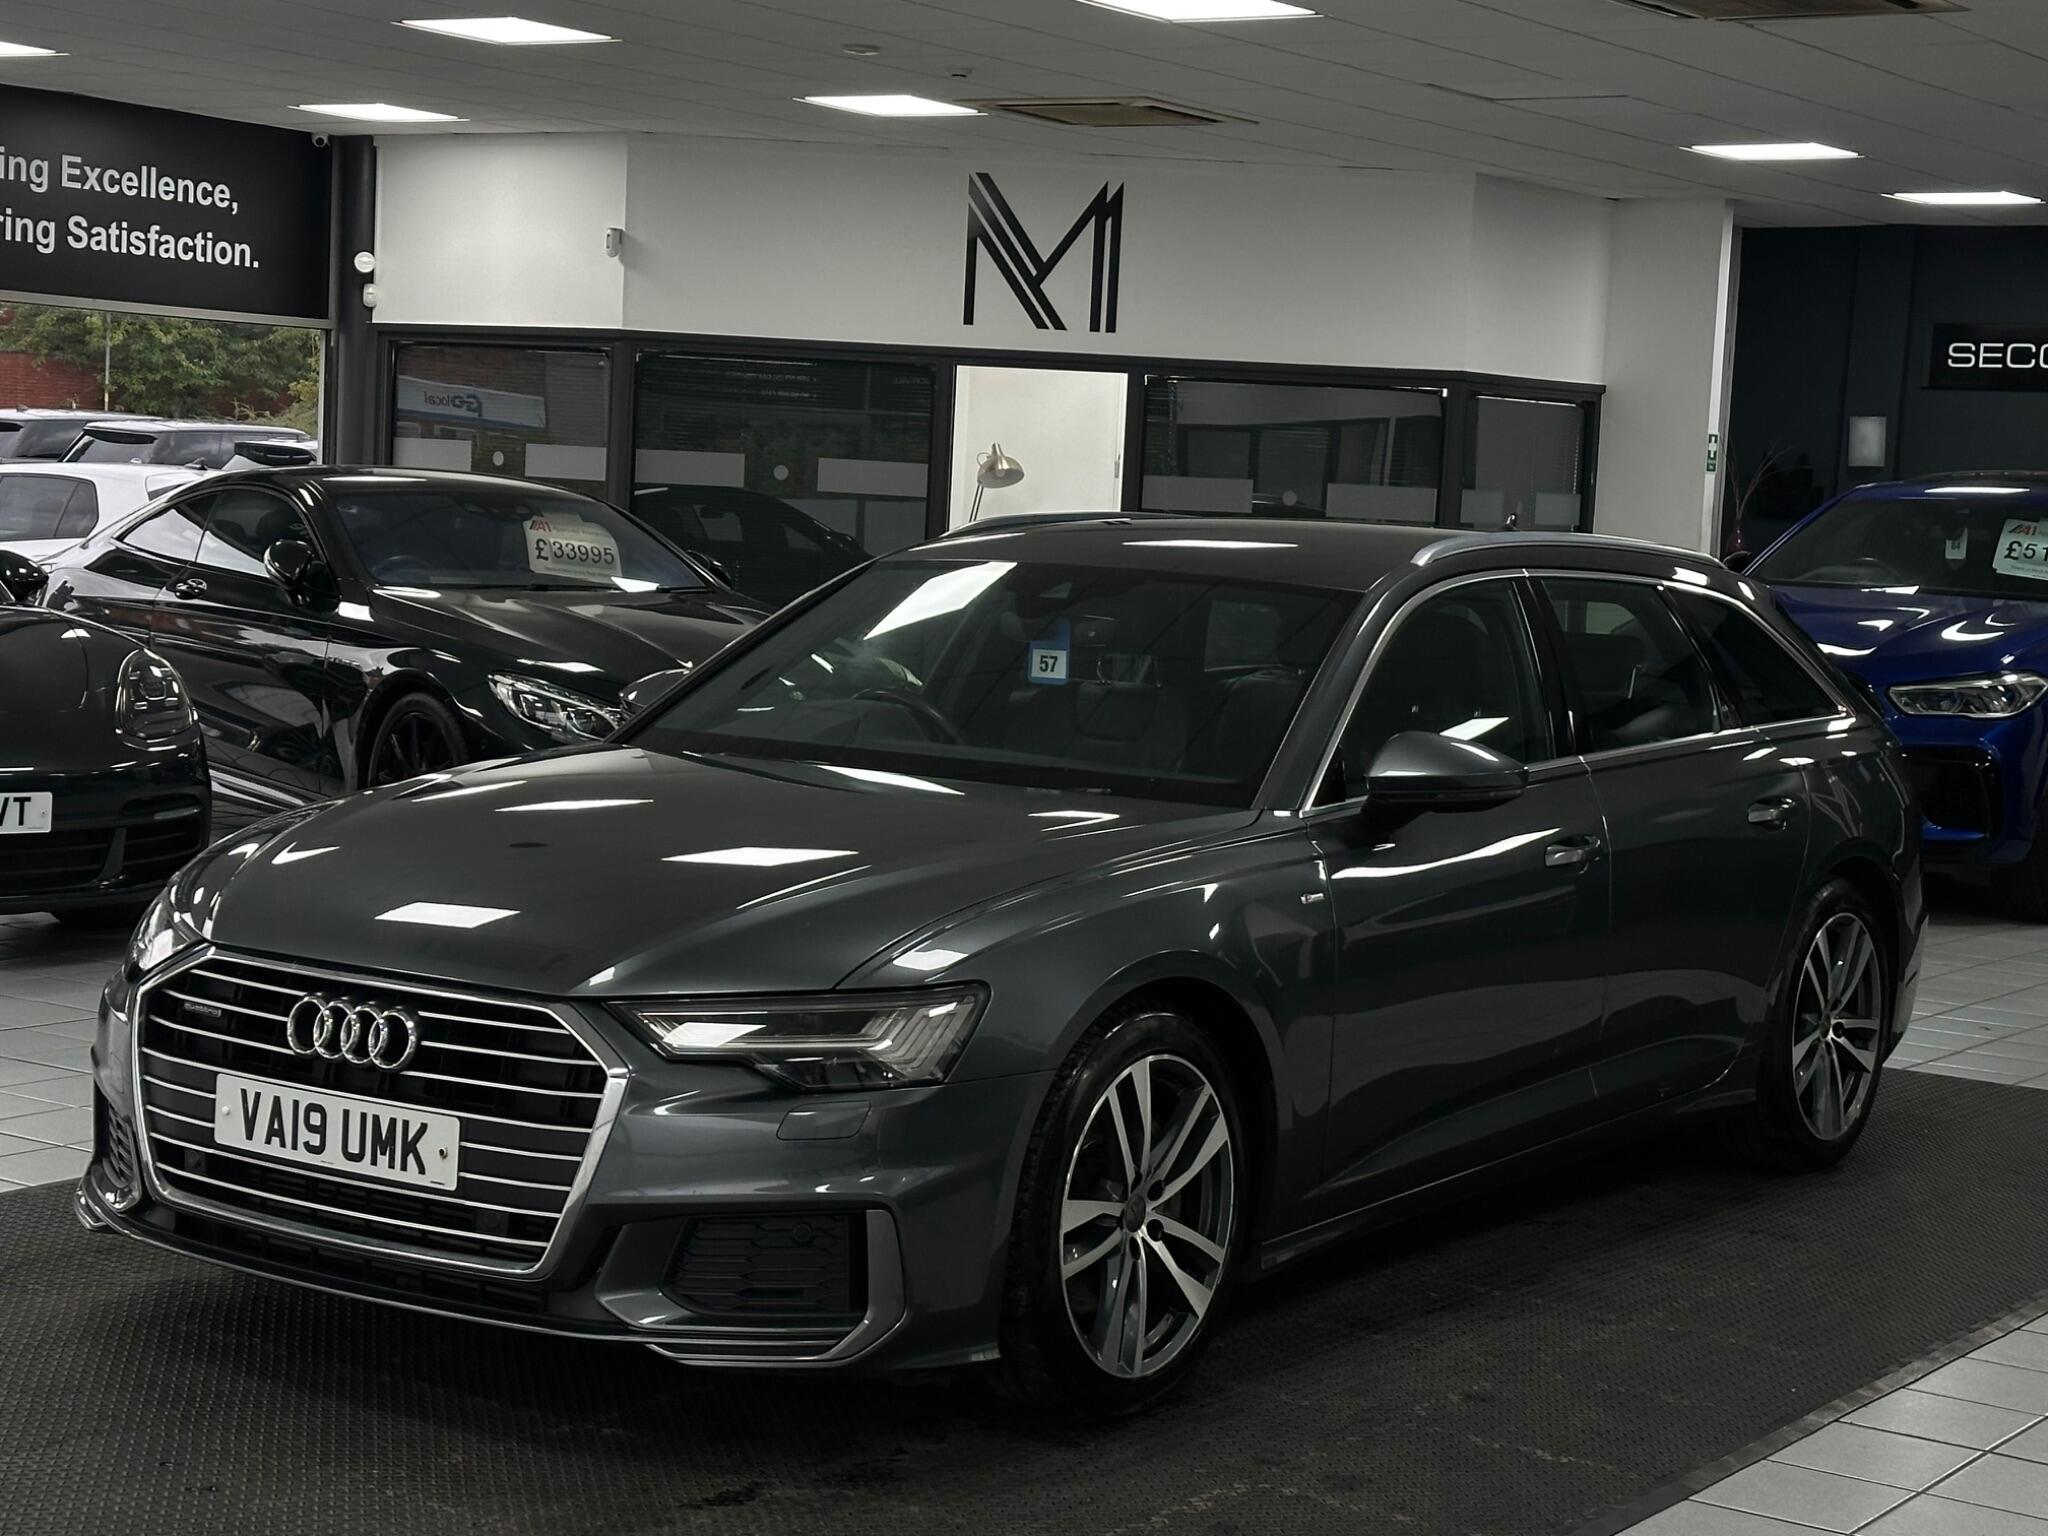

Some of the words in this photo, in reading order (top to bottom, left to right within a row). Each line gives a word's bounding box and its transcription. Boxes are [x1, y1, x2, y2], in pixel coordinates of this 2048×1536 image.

[61, 154, 239, 215] Excellence,
[0, 207, 56, 255] ing
[66, 215, 260, 269] Satisfaction.
[1947, 342, 2048, 369] SEC
[535, 538, 615, 565] £33995
[1039, 654, 1059, 673] 57
[239, 1087, 328, 1156] VA19
[341, 1108, 430, 1176] UMK
